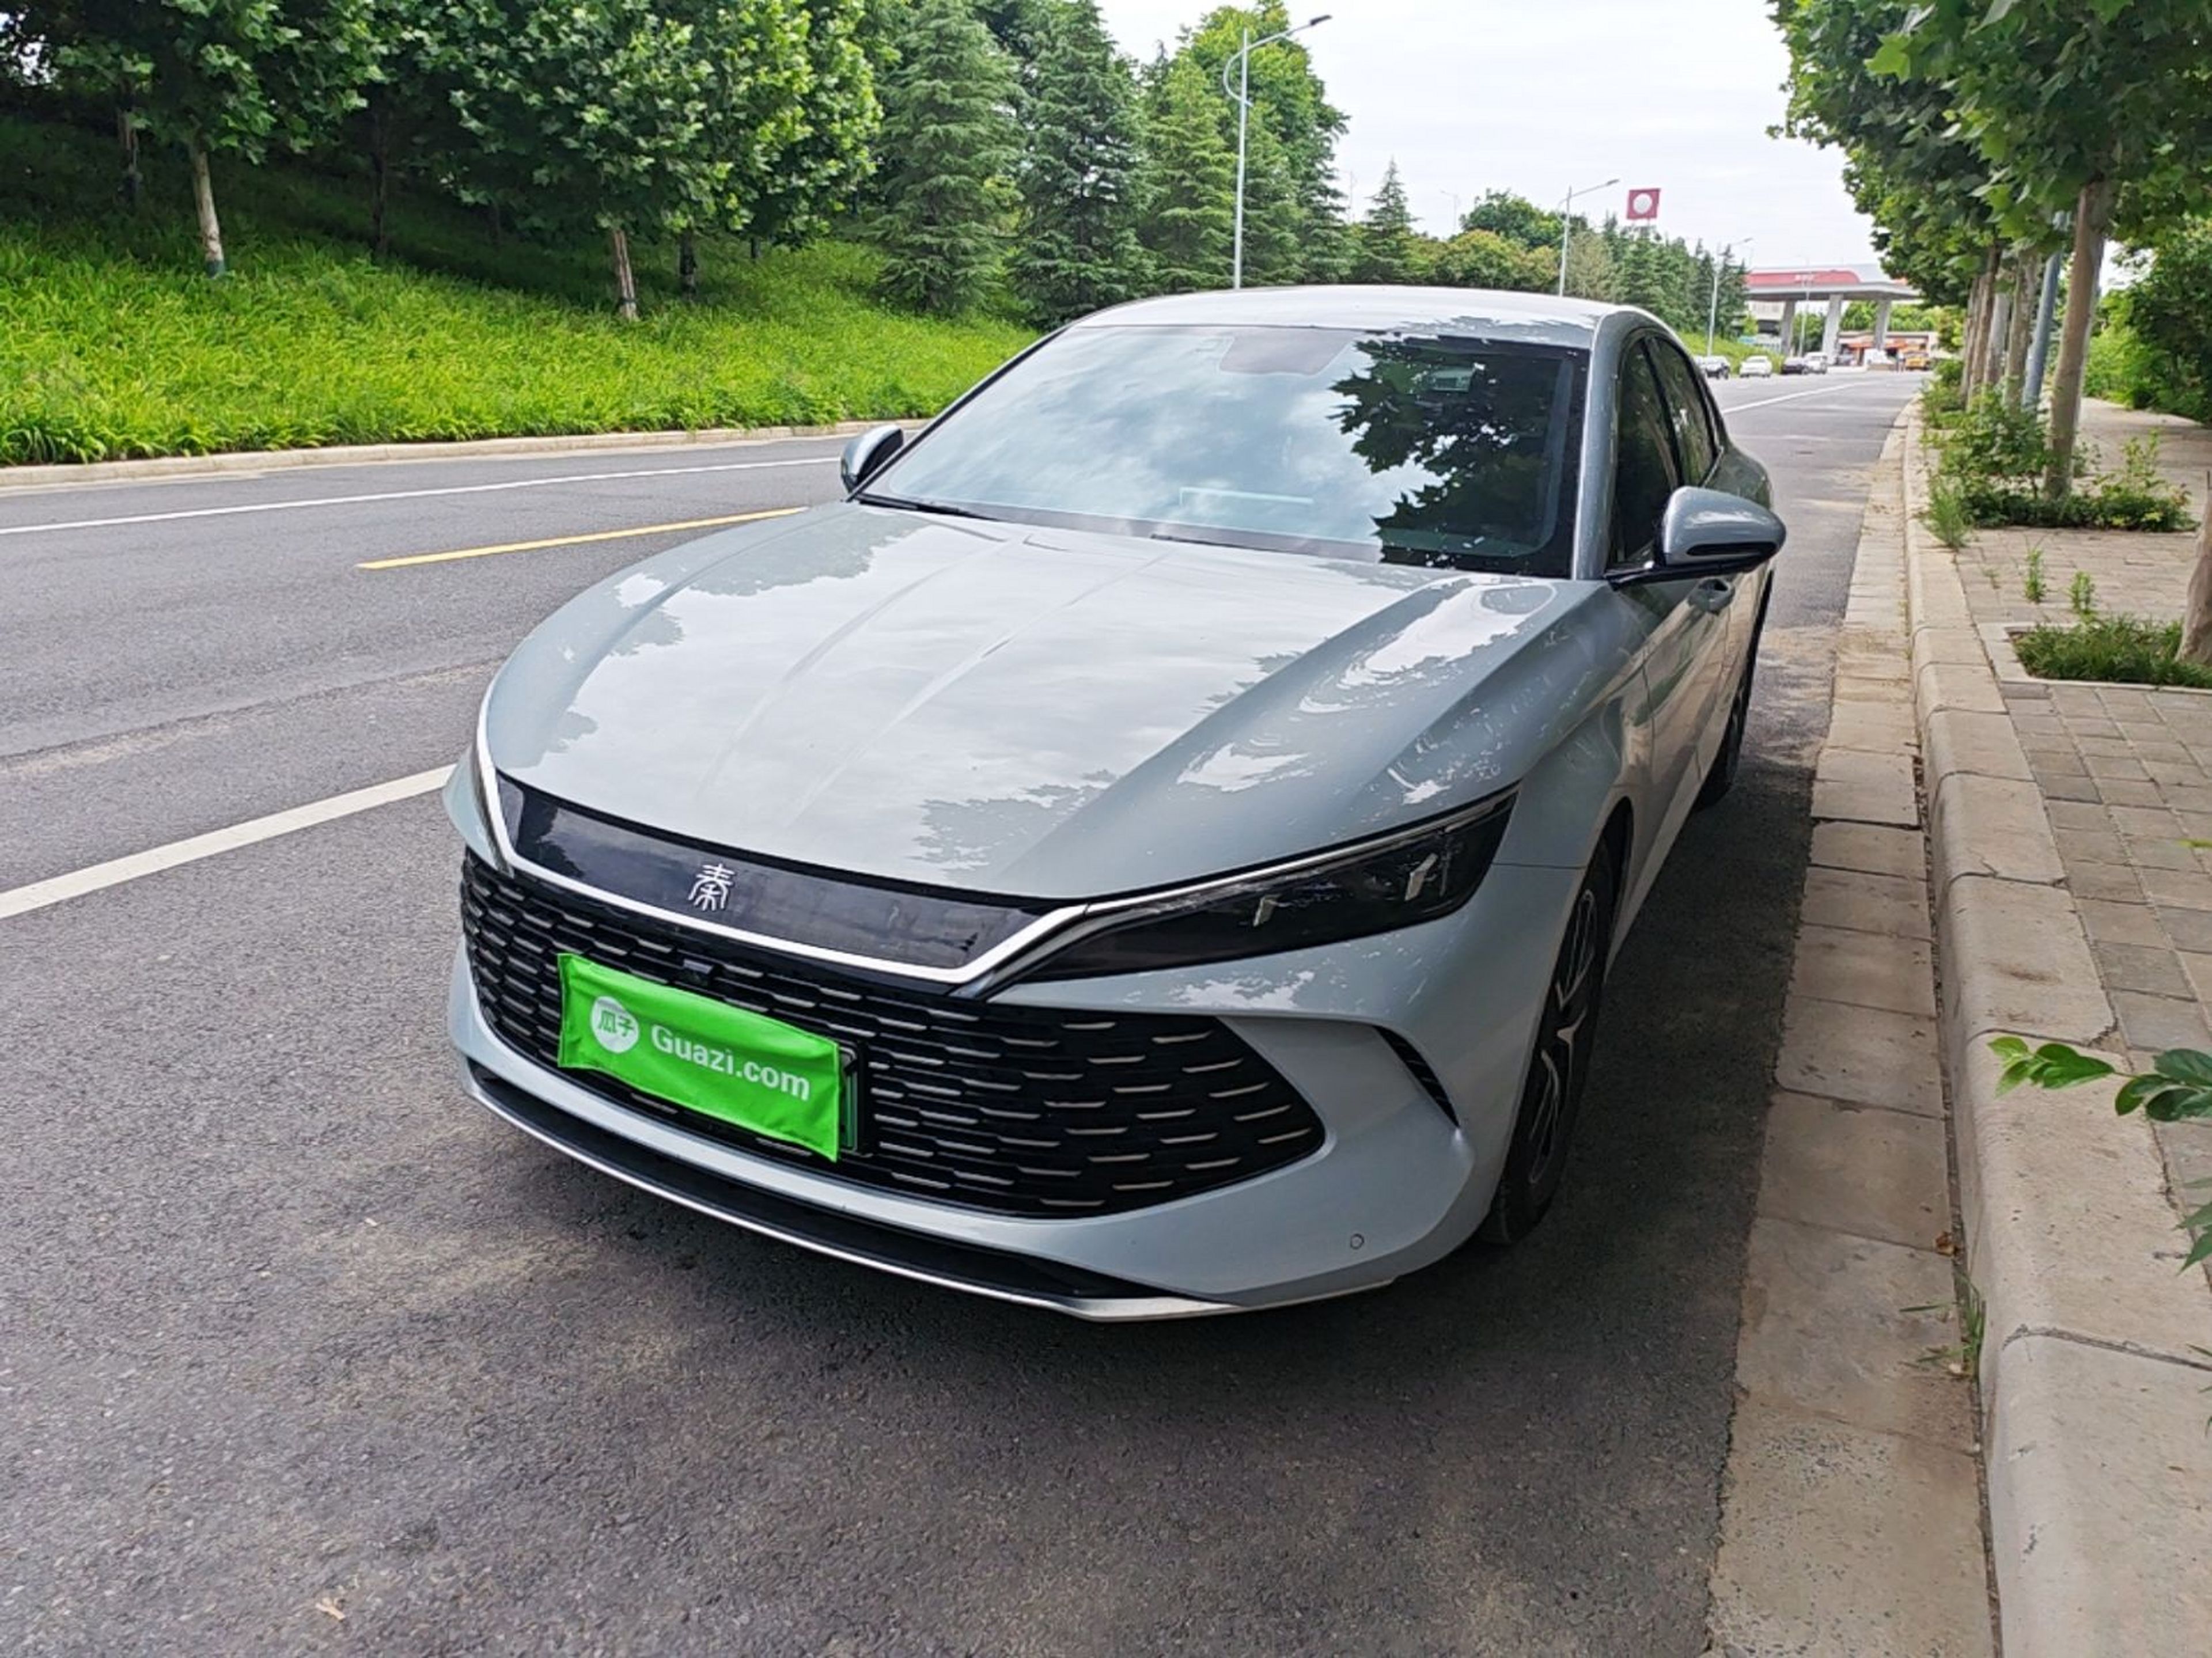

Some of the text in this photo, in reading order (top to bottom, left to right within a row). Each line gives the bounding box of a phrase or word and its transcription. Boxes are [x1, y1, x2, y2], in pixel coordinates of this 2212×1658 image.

[688, 863, 734, 910] 秦
[598, 1010, 634, 1037] 瓜子
[651, 1024, 810, 1101] Guazi.com
